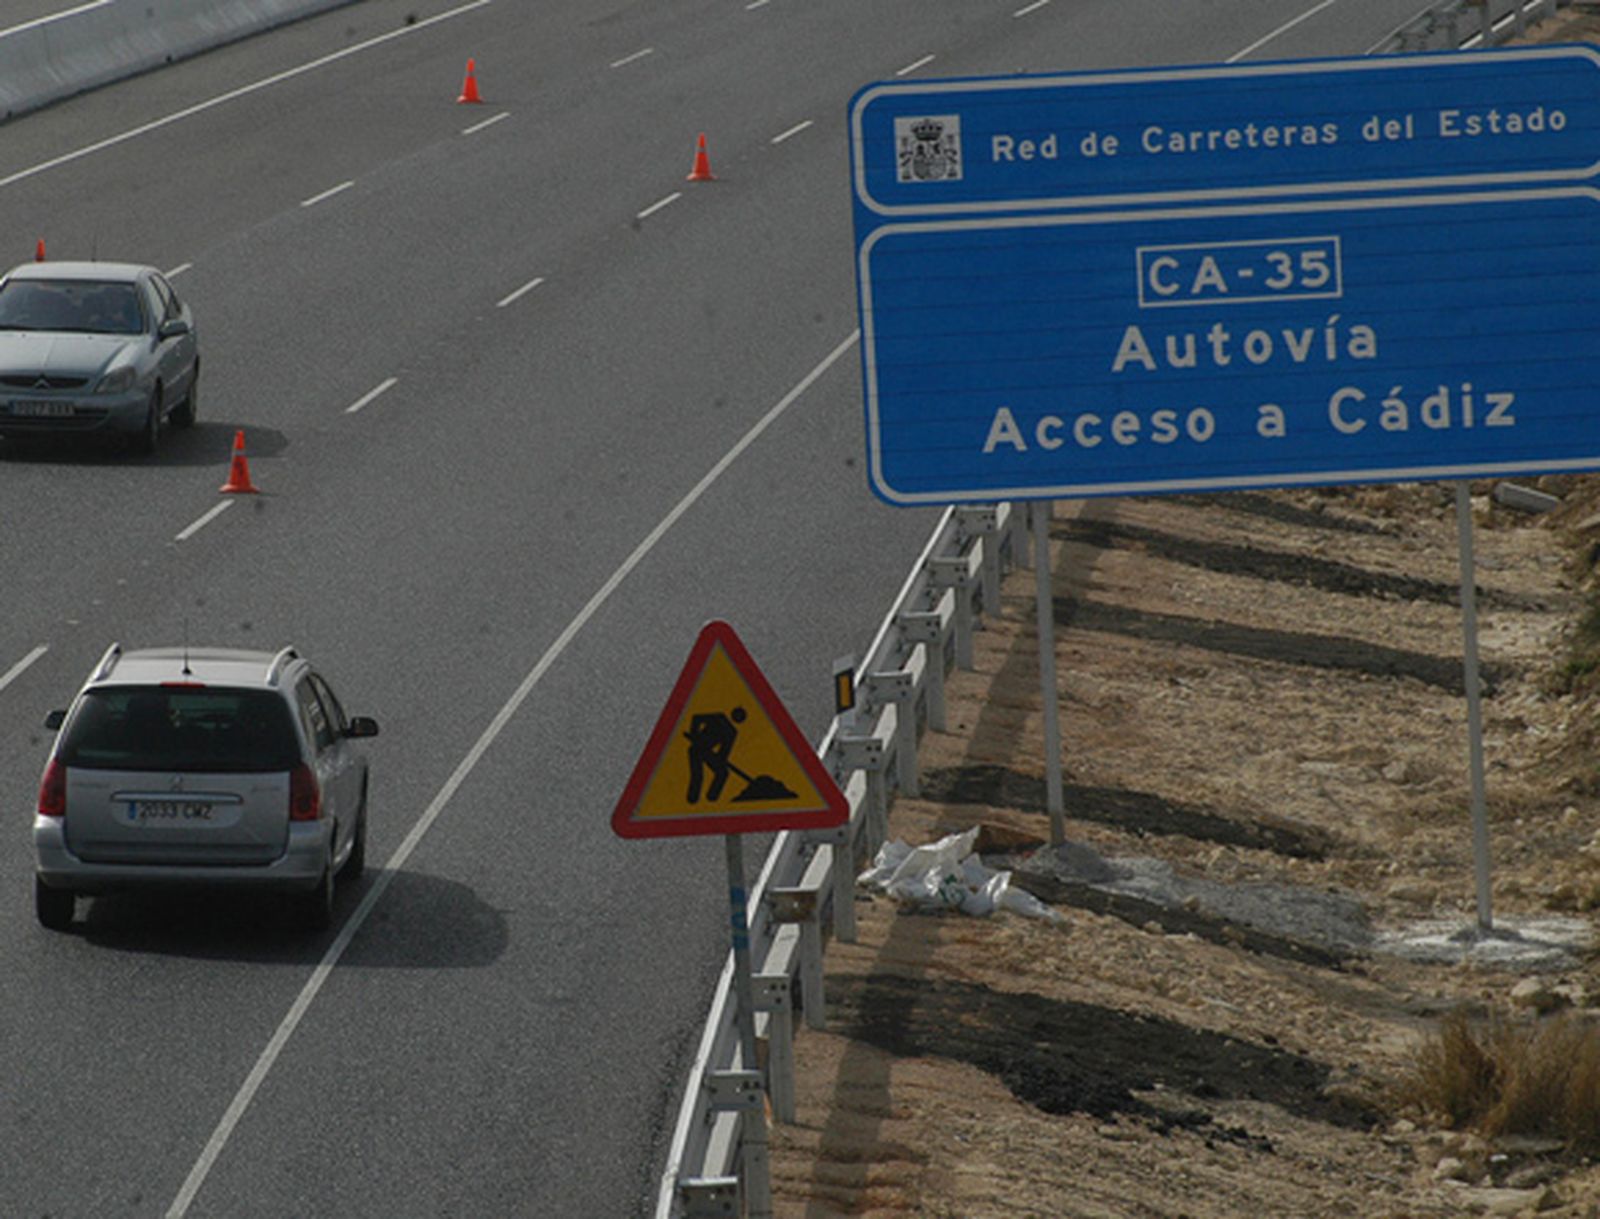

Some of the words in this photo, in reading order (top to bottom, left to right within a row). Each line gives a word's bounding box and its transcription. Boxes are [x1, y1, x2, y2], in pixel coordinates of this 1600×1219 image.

[992, 134, 1057, 162] Red
[1080, 132, 1118, 157] de
[1142, 123, 1338, 154] Carreteras
[1362, 115, 1414, 141] del
[1439, 107, 1567, 137] Estado
[1148, 250, 1332, 297] CA-35
[1111, 314, 1377, 373] Autovía
[981, 407, 1216, 455] Acceso
[1257, 404, 1286, 438] a
[1328, 382, 1516, 435] Cádiz
